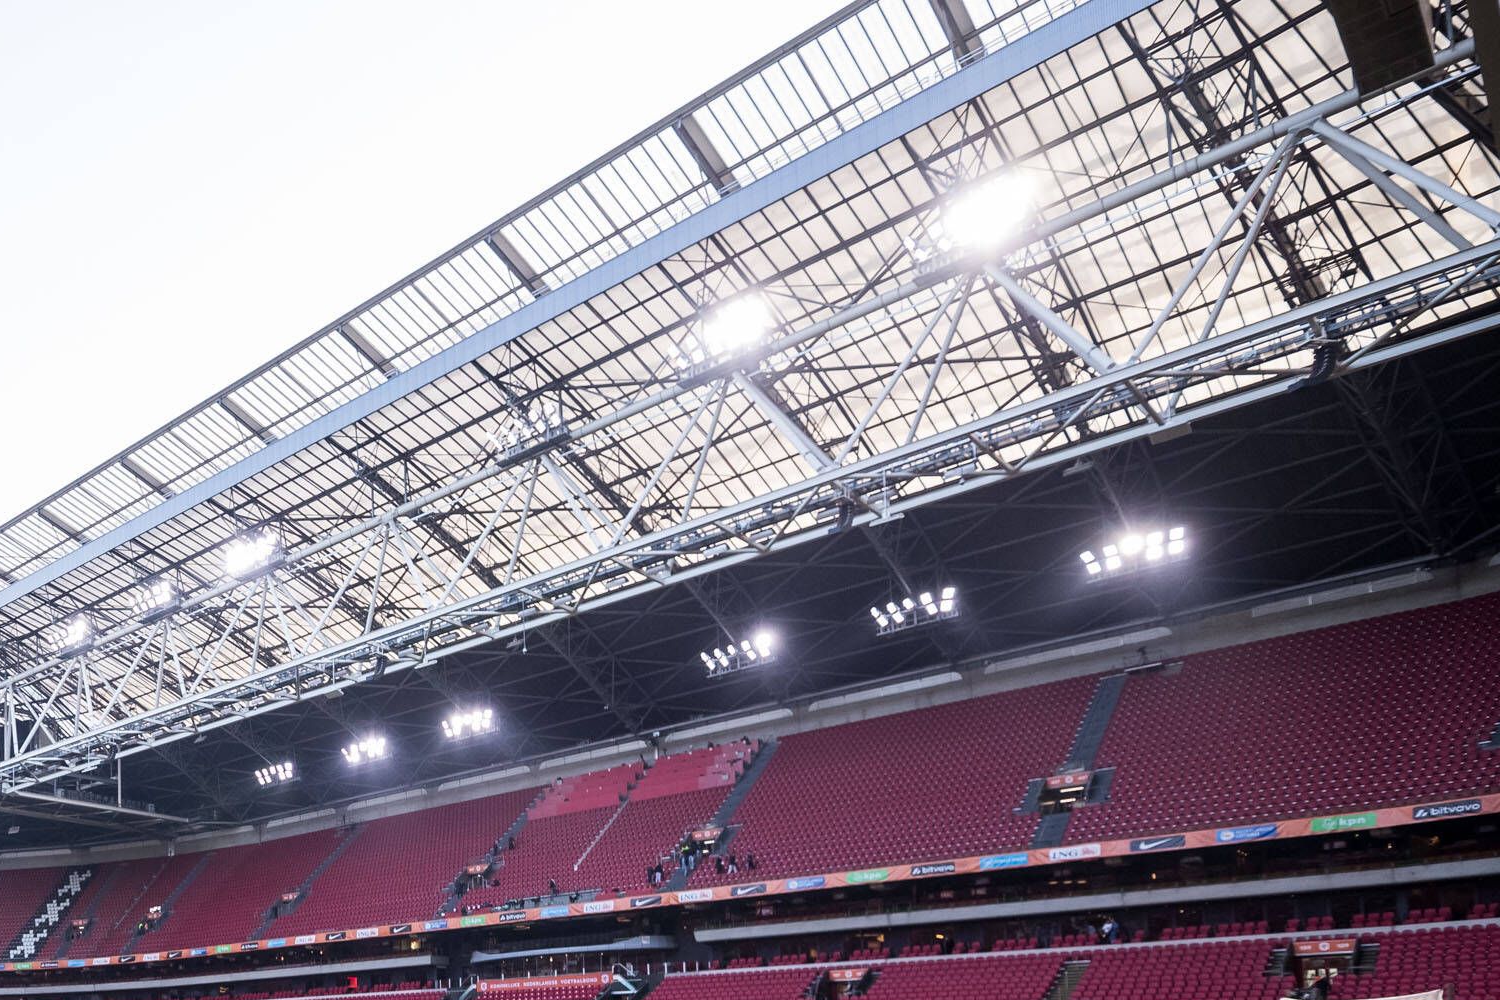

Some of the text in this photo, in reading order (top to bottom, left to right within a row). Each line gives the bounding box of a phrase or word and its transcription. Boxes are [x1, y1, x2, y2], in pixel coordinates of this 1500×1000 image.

[1430, 803, 1481, 815] bitvavo
[1339, 817, 1366, 827] kpn
[1052, 849, 1078, 859] ING
[922, 864, 954, 874] bitvavo
